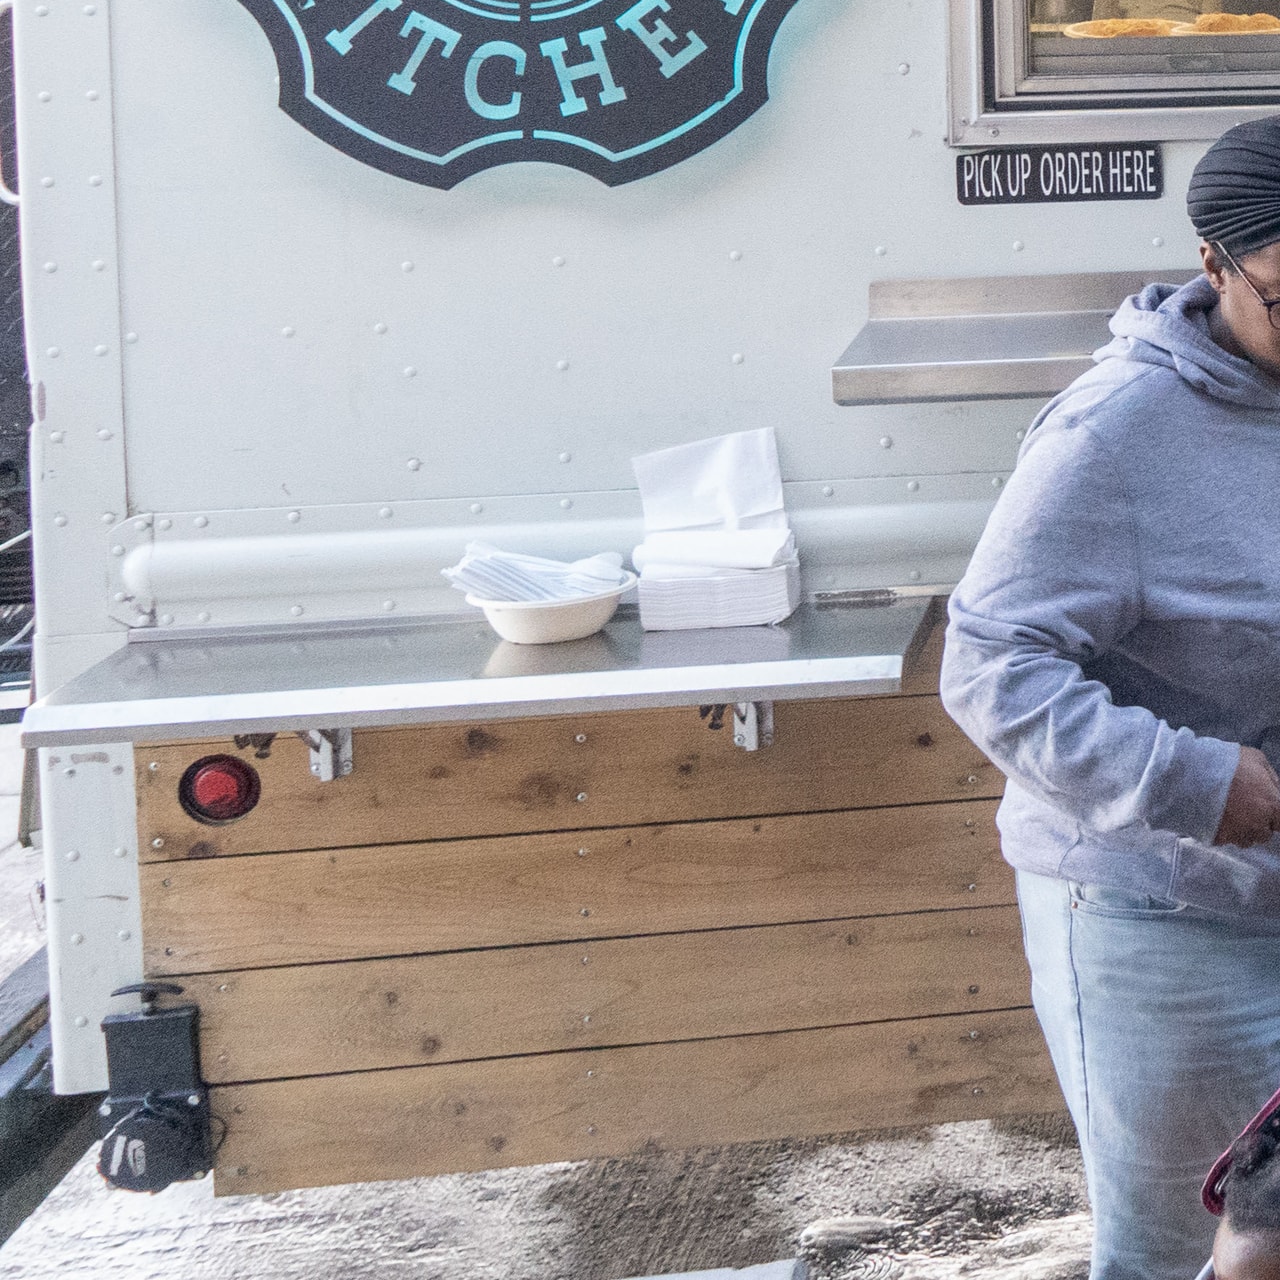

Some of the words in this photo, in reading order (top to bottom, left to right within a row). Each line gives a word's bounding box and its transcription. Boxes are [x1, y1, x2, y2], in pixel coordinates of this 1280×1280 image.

[964, 155, 1004, 197] PICK
[1007, 154, 1031, 196] UP
[1040, 152, 1104, 196] ORDER
[1109, 150, 1157, 193] HERE
